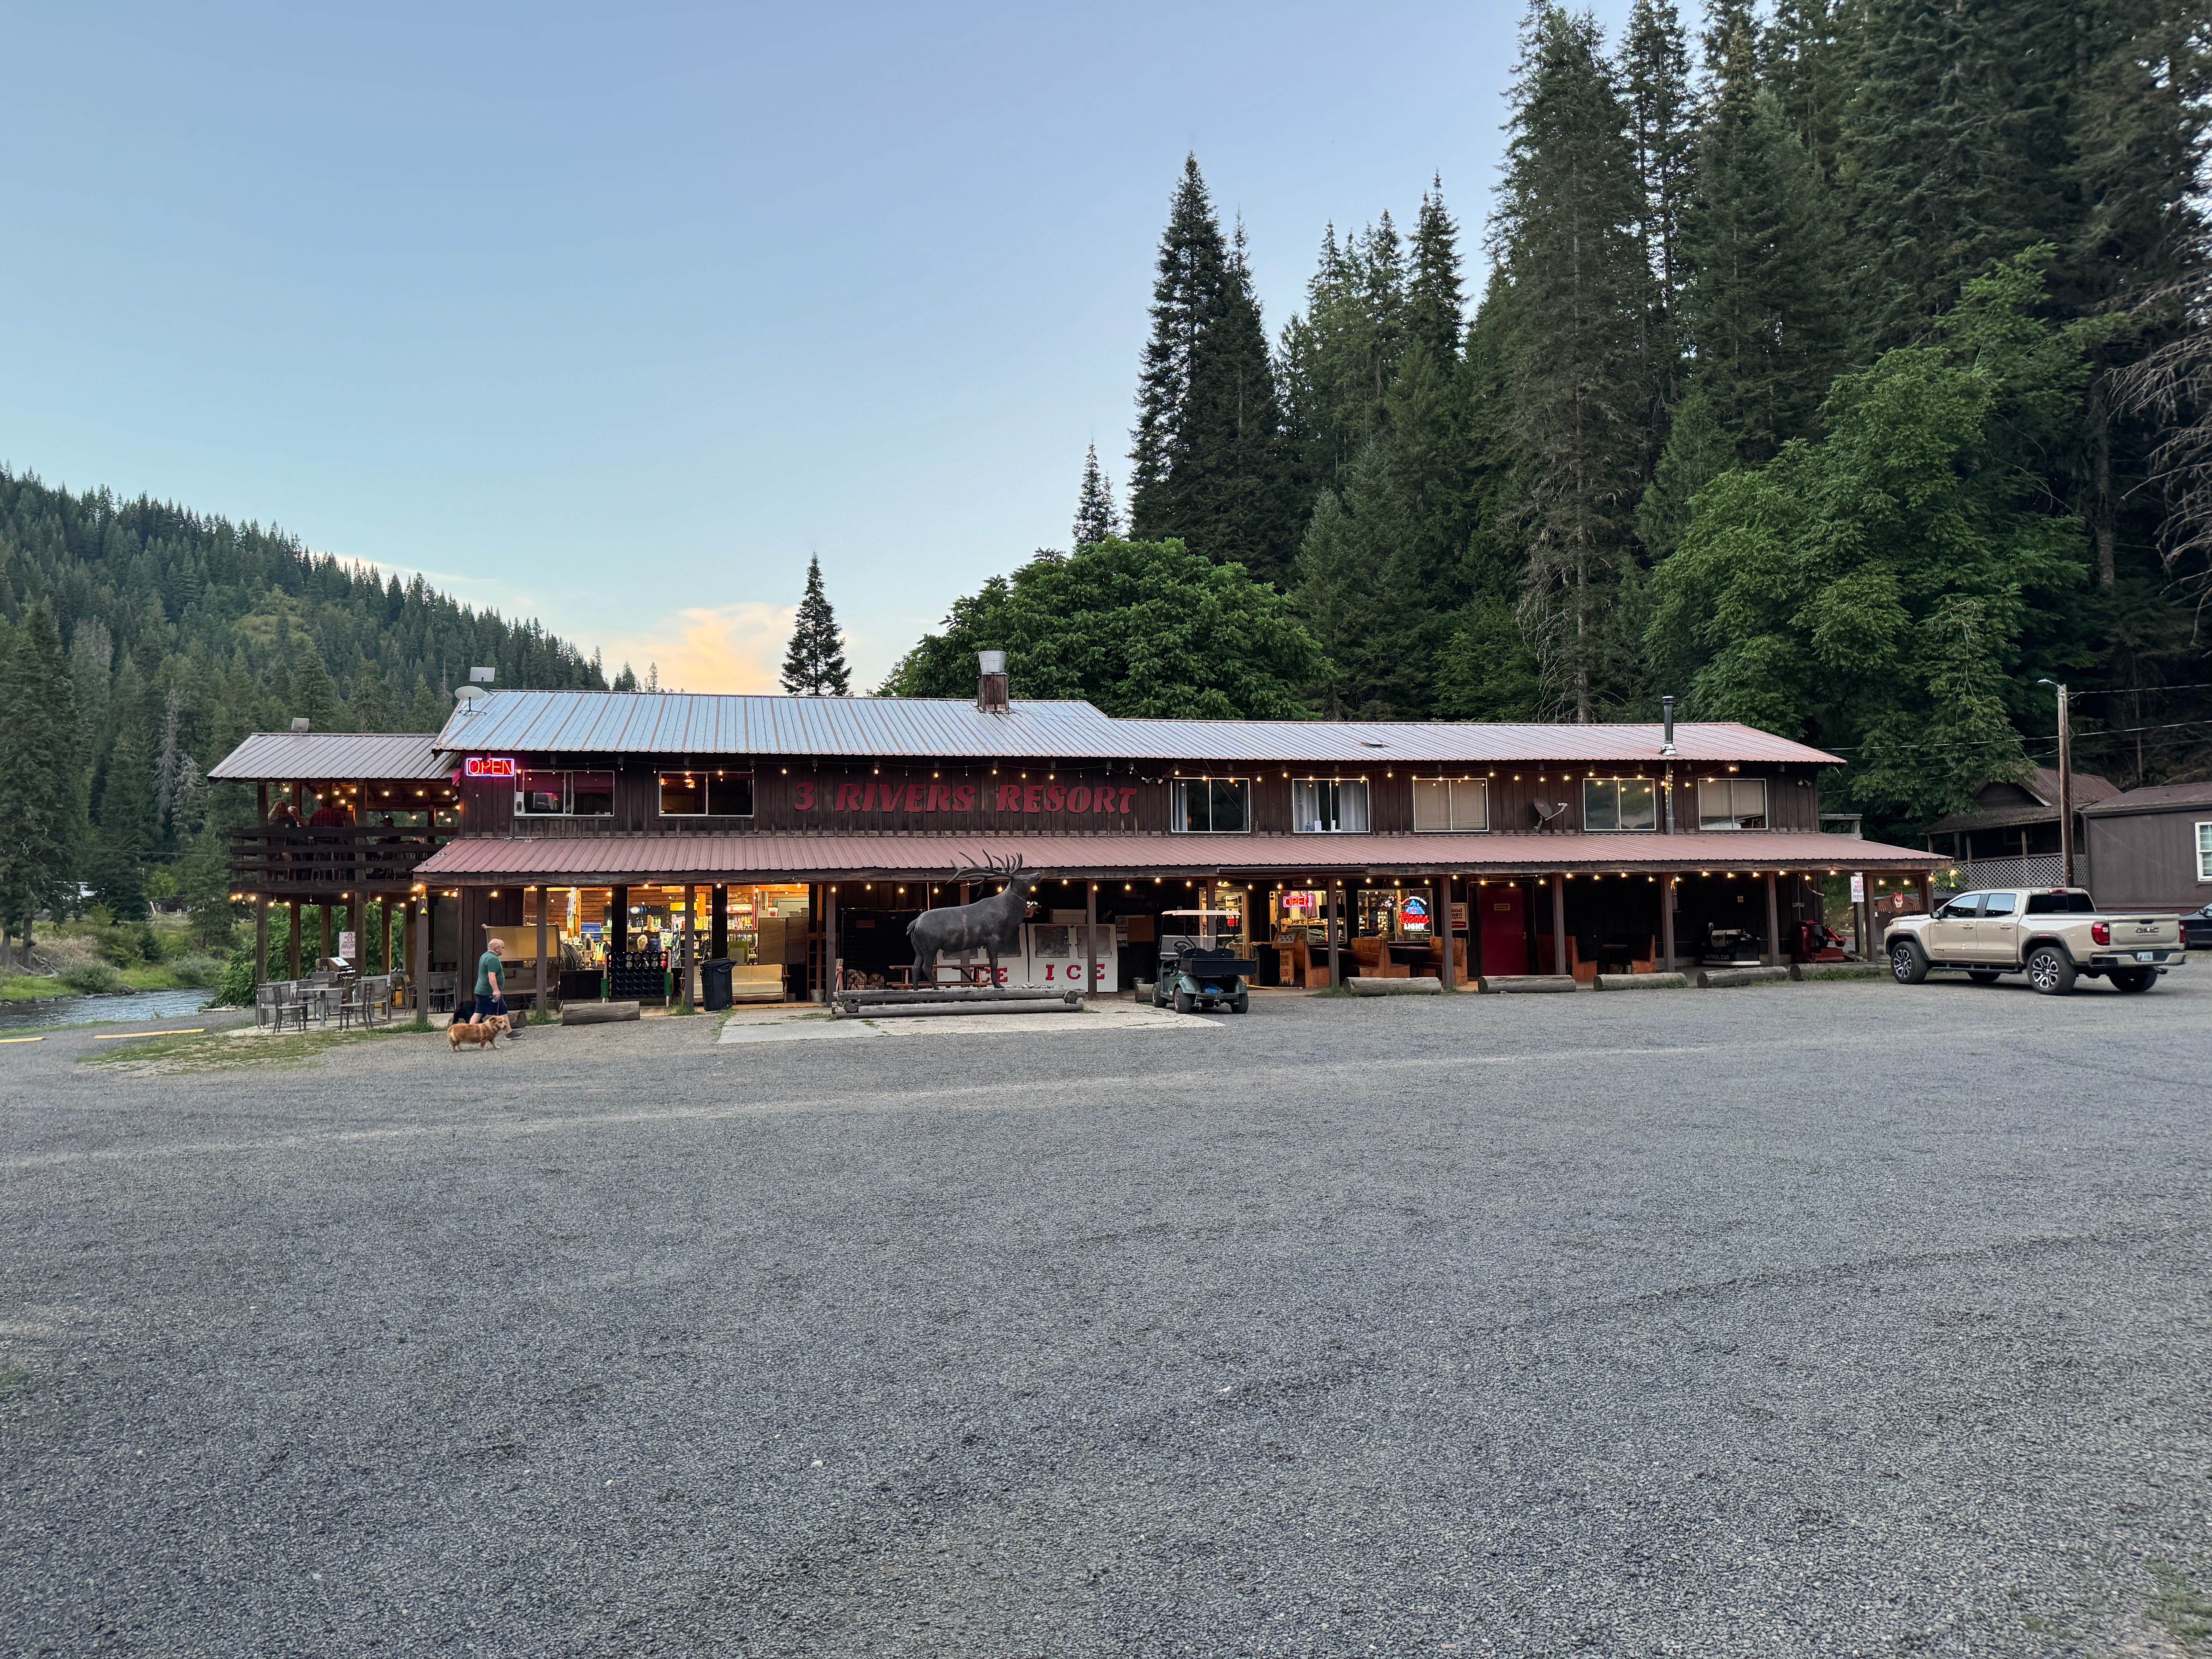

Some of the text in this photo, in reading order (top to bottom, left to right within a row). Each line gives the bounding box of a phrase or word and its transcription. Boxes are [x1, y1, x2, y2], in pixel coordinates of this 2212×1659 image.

[469, 759, 513, 775] OPEN
[794, 781, 1137, 814] 3 RIVERS RESORT
[1285, 896, 1310, 906] OPEN
[1046, 964, 1105, 980] ICE
